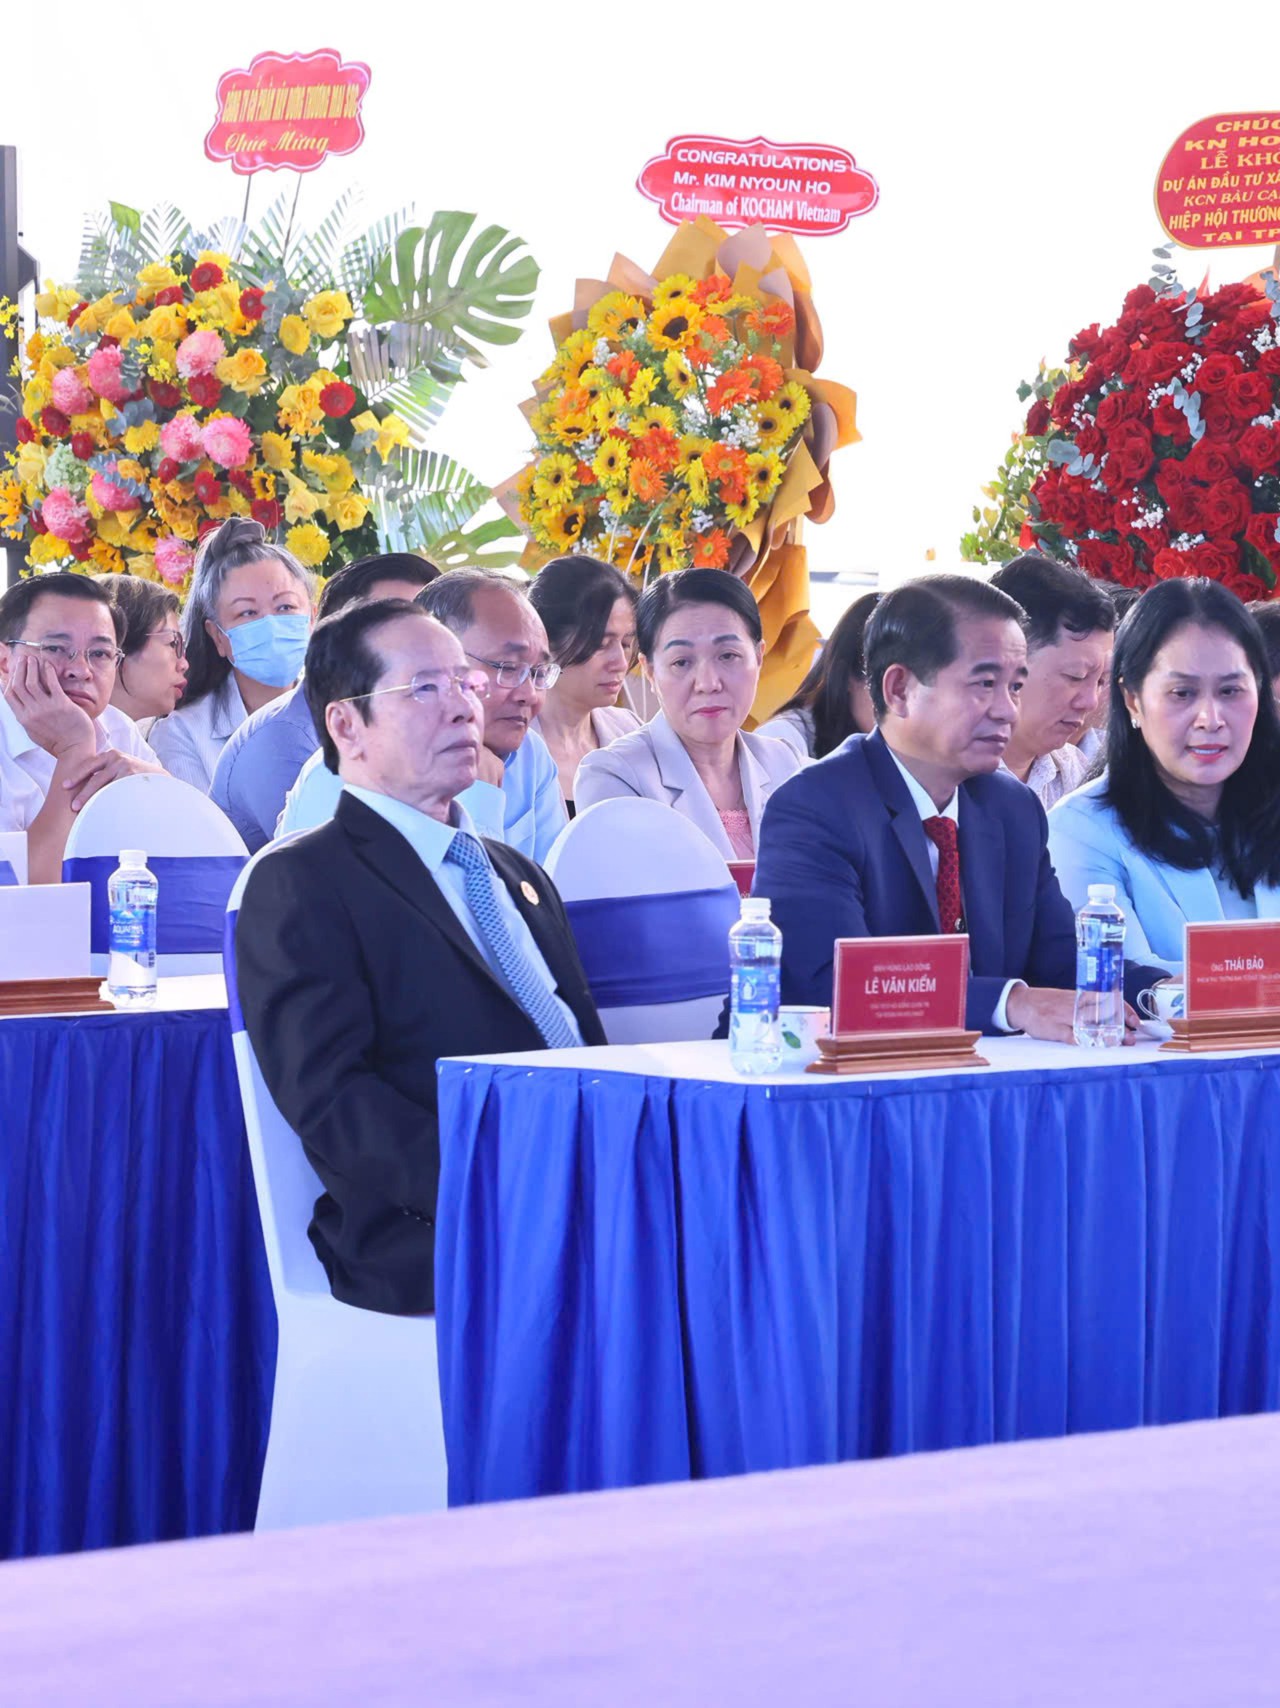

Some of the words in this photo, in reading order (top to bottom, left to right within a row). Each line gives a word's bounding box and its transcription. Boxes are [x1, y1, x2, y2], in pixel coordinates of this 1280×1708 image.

[225, 133, 268, 153] Chúc
[270, 129, 330, 155] Mừng
[1184, 138, 1228, 151] KN
[677, 148, 847, 173] CONGRATULATIONS
[1200, 150, 1228, 169] LỄ
[673, 171, 700, 185] Mr.
[704, 173, 735, 188] KIM
[739, 175, 801, 193] NYOUN
[805, 181, 831, 195] HO
[1162, 177, 1185, 194] DỰ
[1186, 176, 1207, 191] ÁN
[1211, 170, 1240, 189] ĐẦU
[1244, 171, 1265, 186] TƯ
[671, 191, 723, 215] Chairman
[726, 195, 739, 215] of
[740, 198, 794, 220] KOCHAM
[796, 201, 841, 223] Vietnam
[1183, 194, 1217, 207] KCN
[1220, 189, 1254, 204] BÀU
[1169, 210, 1201, 232] HIỆP
[1204, 207, 1228, 228] HỘI
[1202, 231, 1242, 243] TẠI
[1224, 956, 1245, 971] THÁI
[865, 976, 879, 994] LÊ
[882, 976, 906, 994] VĂN
